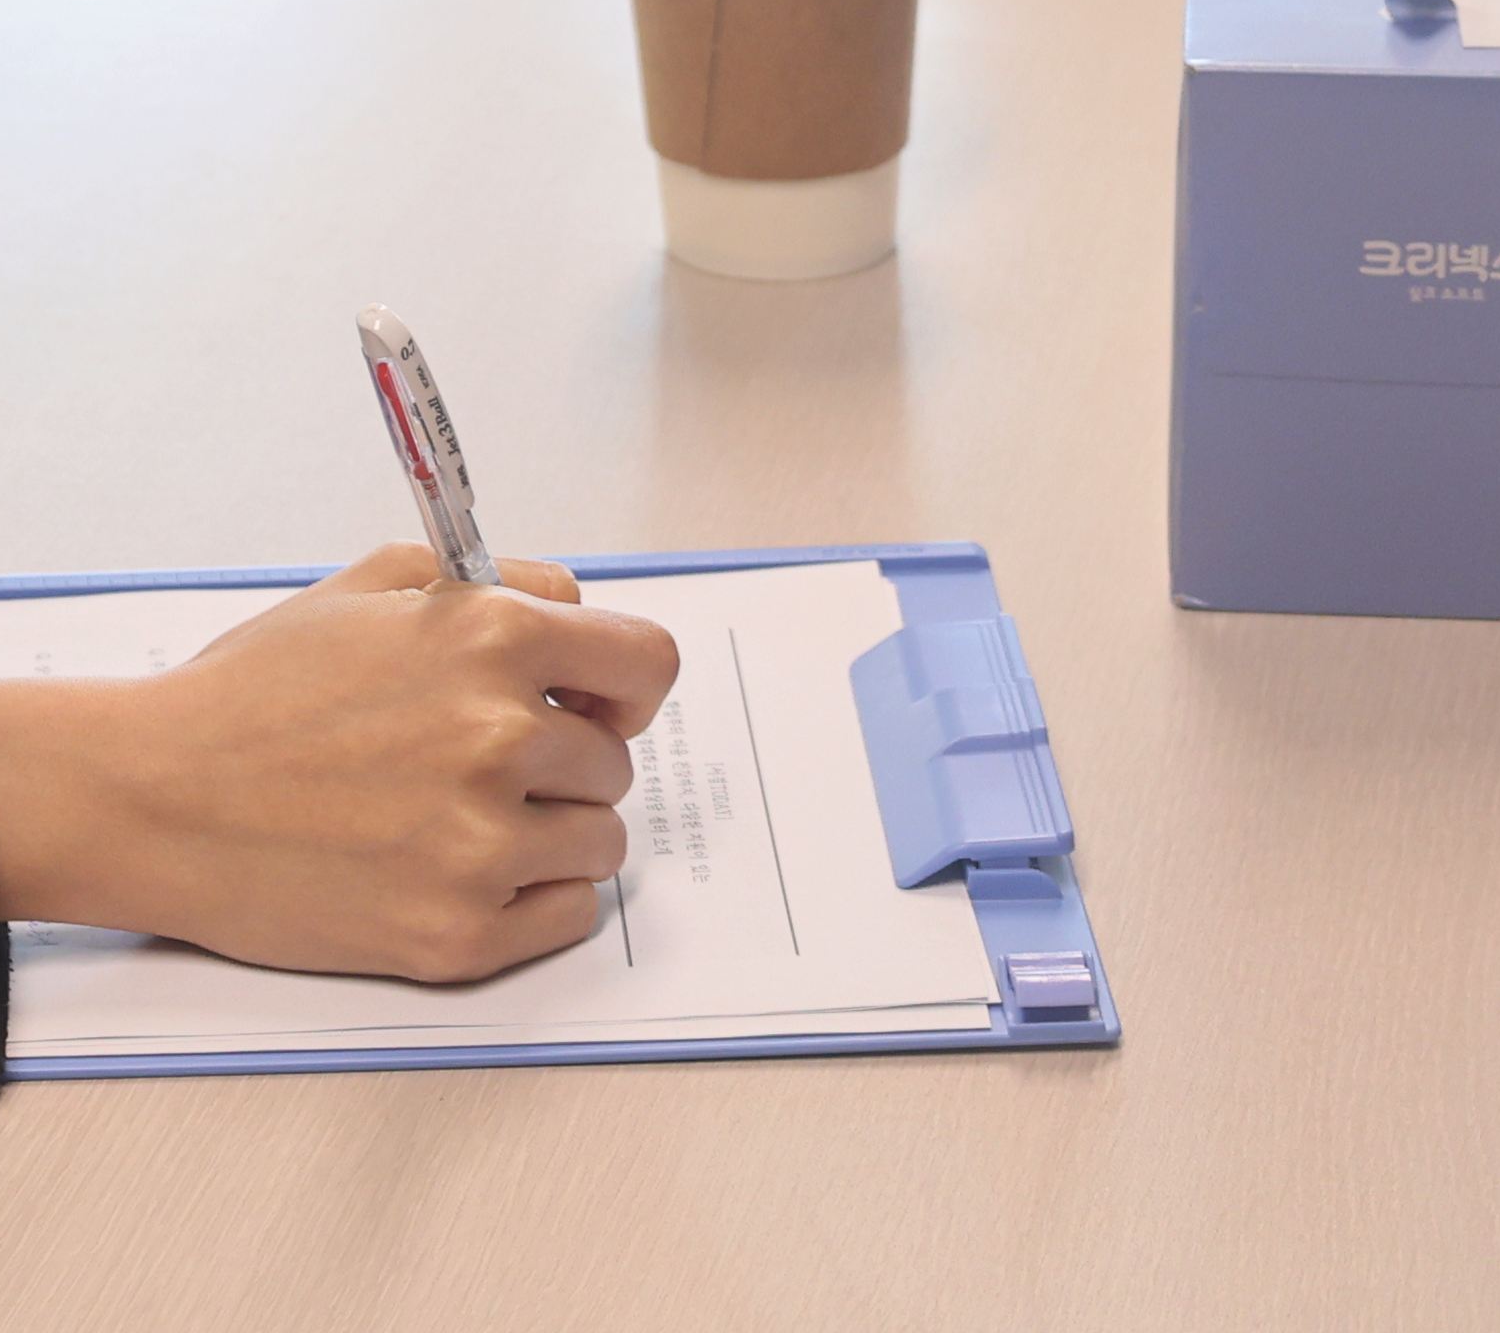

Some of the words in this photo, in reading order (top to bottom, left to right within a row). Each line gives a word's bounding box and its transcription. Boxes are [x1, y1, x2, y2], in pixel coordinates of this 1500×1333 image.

[401, 338, 416, 361] 0.7
[654, 838, 674, 856] 소개
[690, 865, 712, 883] 있는
